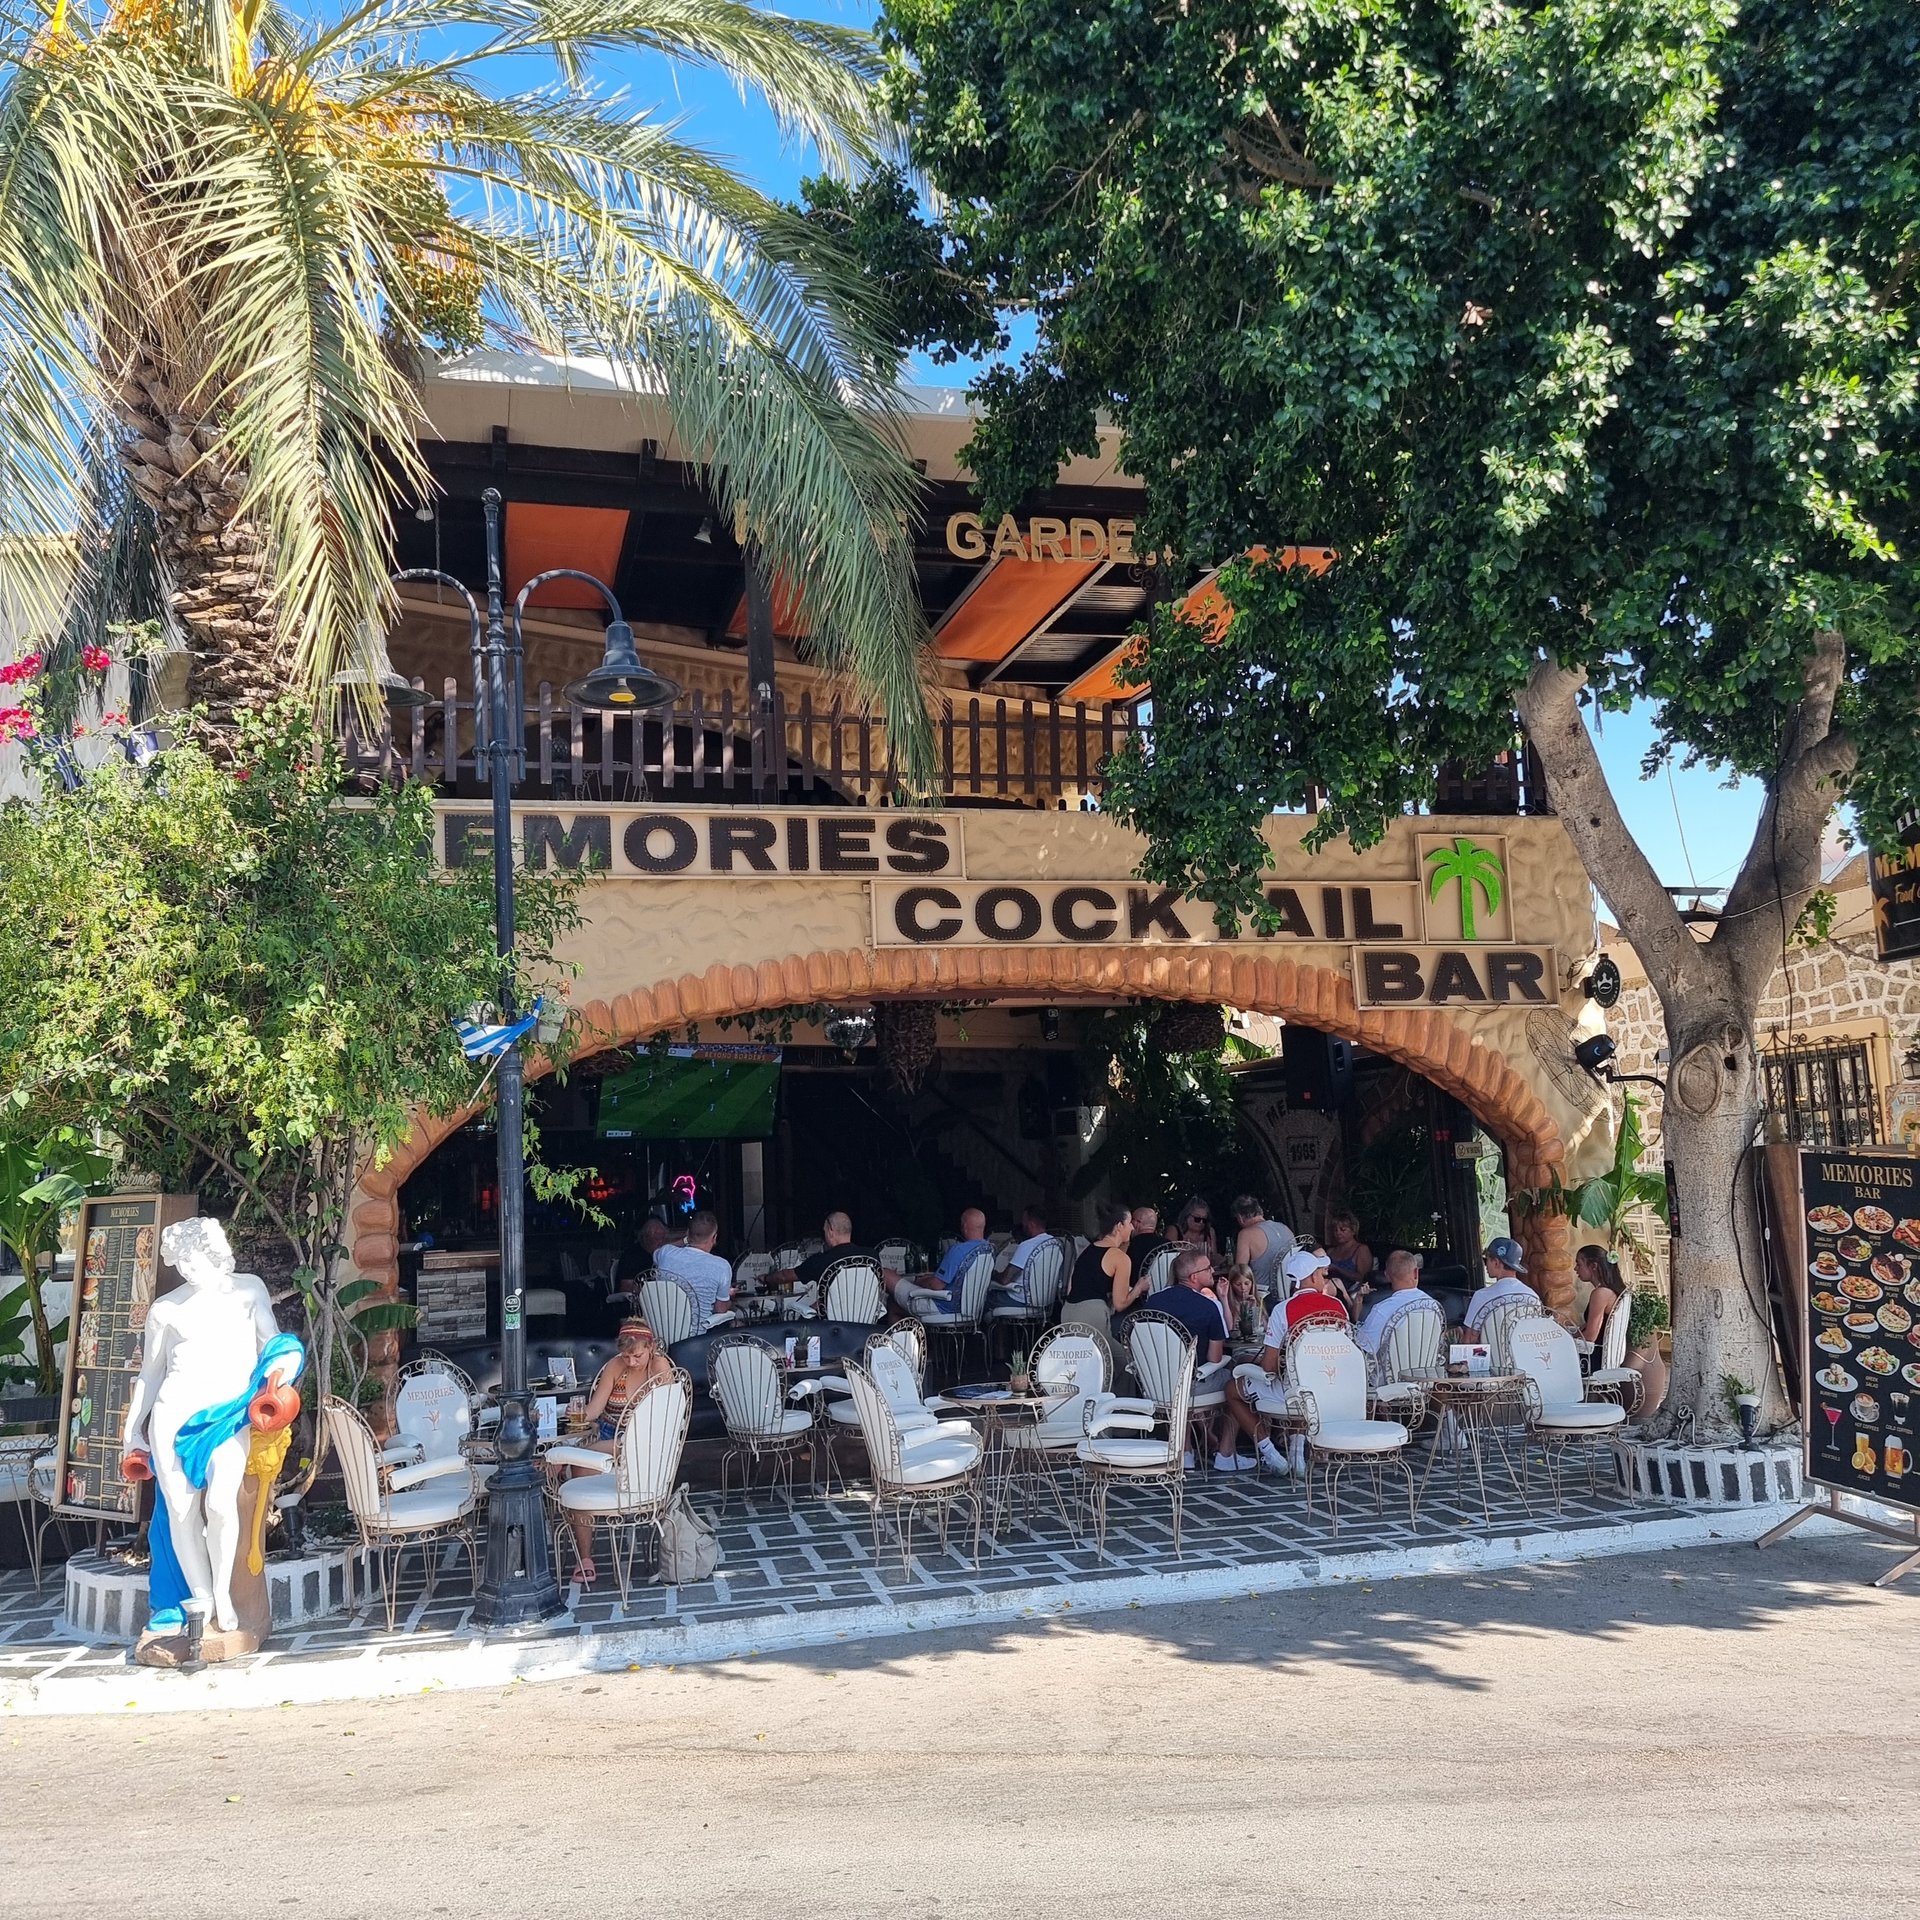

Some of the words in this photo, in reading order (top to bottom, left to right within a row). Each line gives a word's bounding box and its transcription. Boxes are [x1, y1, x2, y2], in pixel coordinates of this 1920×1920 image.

[1364, 952, 1545, 1003] BAR
[1821, 1162, 1913, 1188] MEMORIES
[1855, 1186, 1881, 1200] BAR
[109, 1206, 140, 1218] MEMORIES
[1518, 1330, 1563, 1343] MEMORIES
[1048, 1350, 1093, 1360] MEMORIES
[1303, 1344, 1352, 1355] MEMORIES
[407, 1386, 456, 1401] MEMORIES
